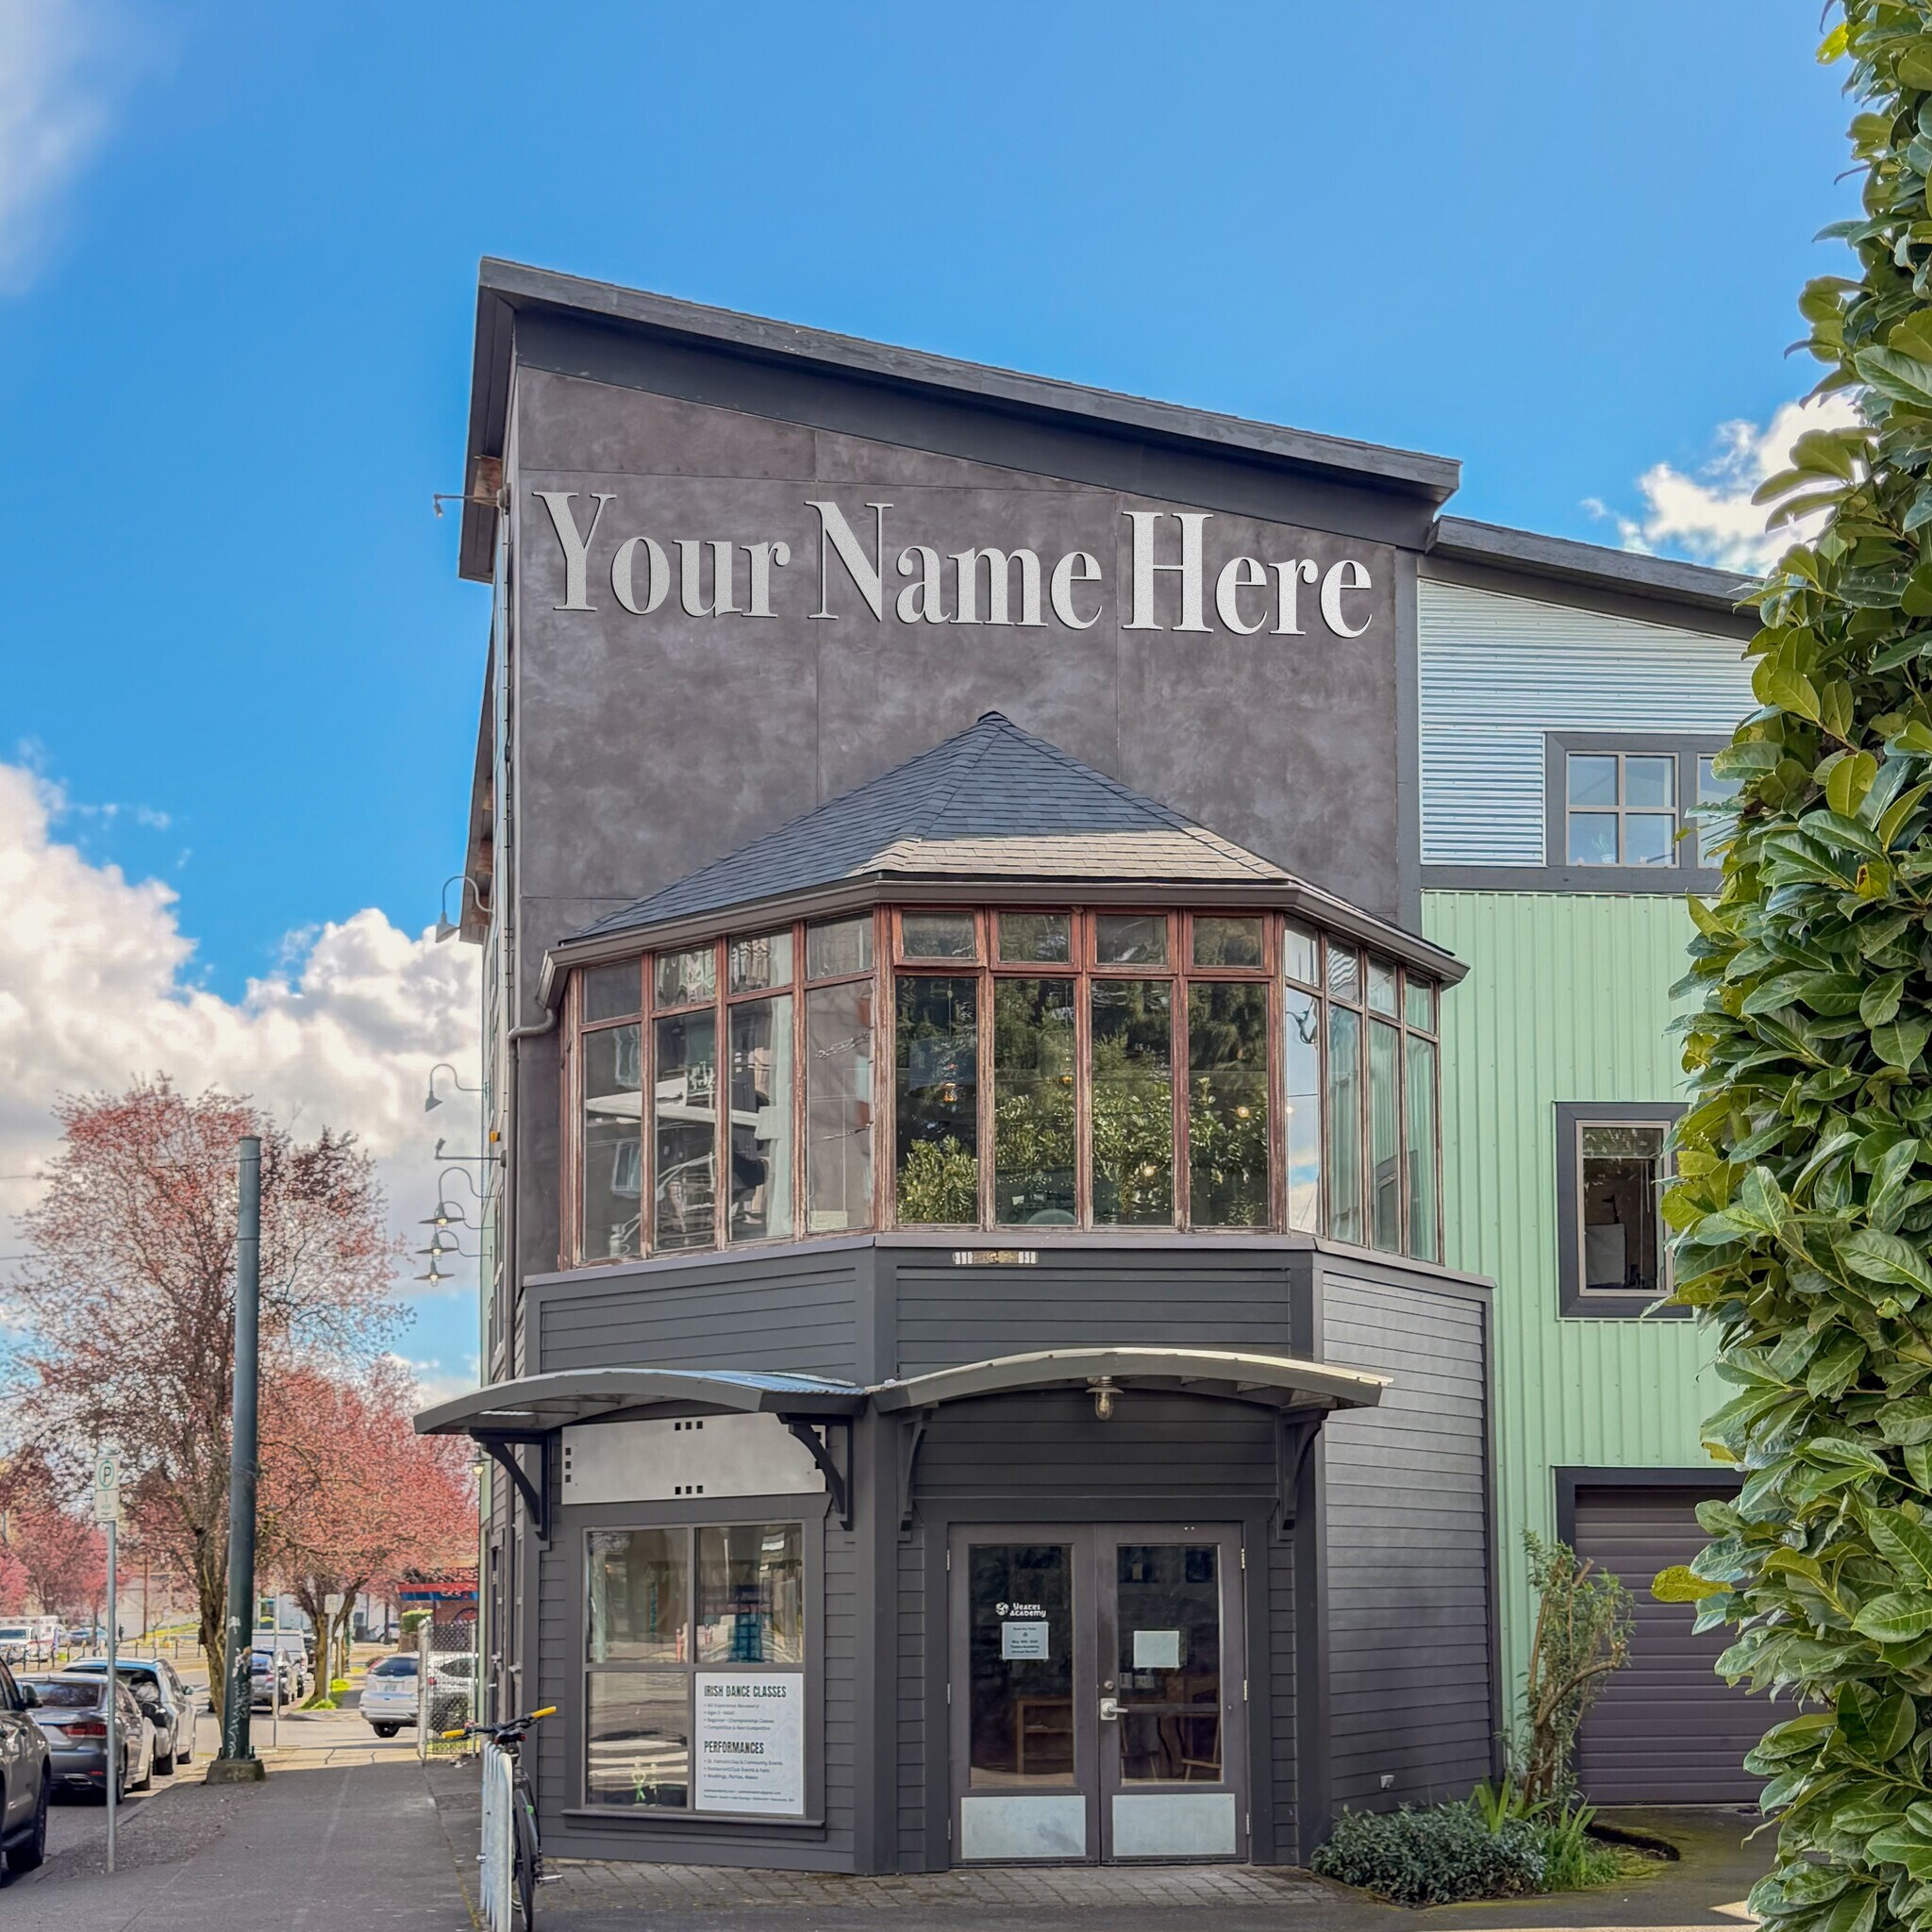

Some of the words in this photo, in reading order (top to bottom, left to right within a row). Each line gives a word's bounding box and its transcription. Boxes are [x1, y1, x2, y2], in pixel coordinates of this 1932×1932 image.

[532, 491, 791, 619] Your
[805, 500, 1103, 630] Name
[1122, 510, 1373, 639] Here
[704, 1685, 724, 1697] IRISH
[725, 1686, 750, 1698] DANCE
[753, 1686, 787, 1698] CLASSES
[704, 1740, 764, 1754] PERFORMANCES
